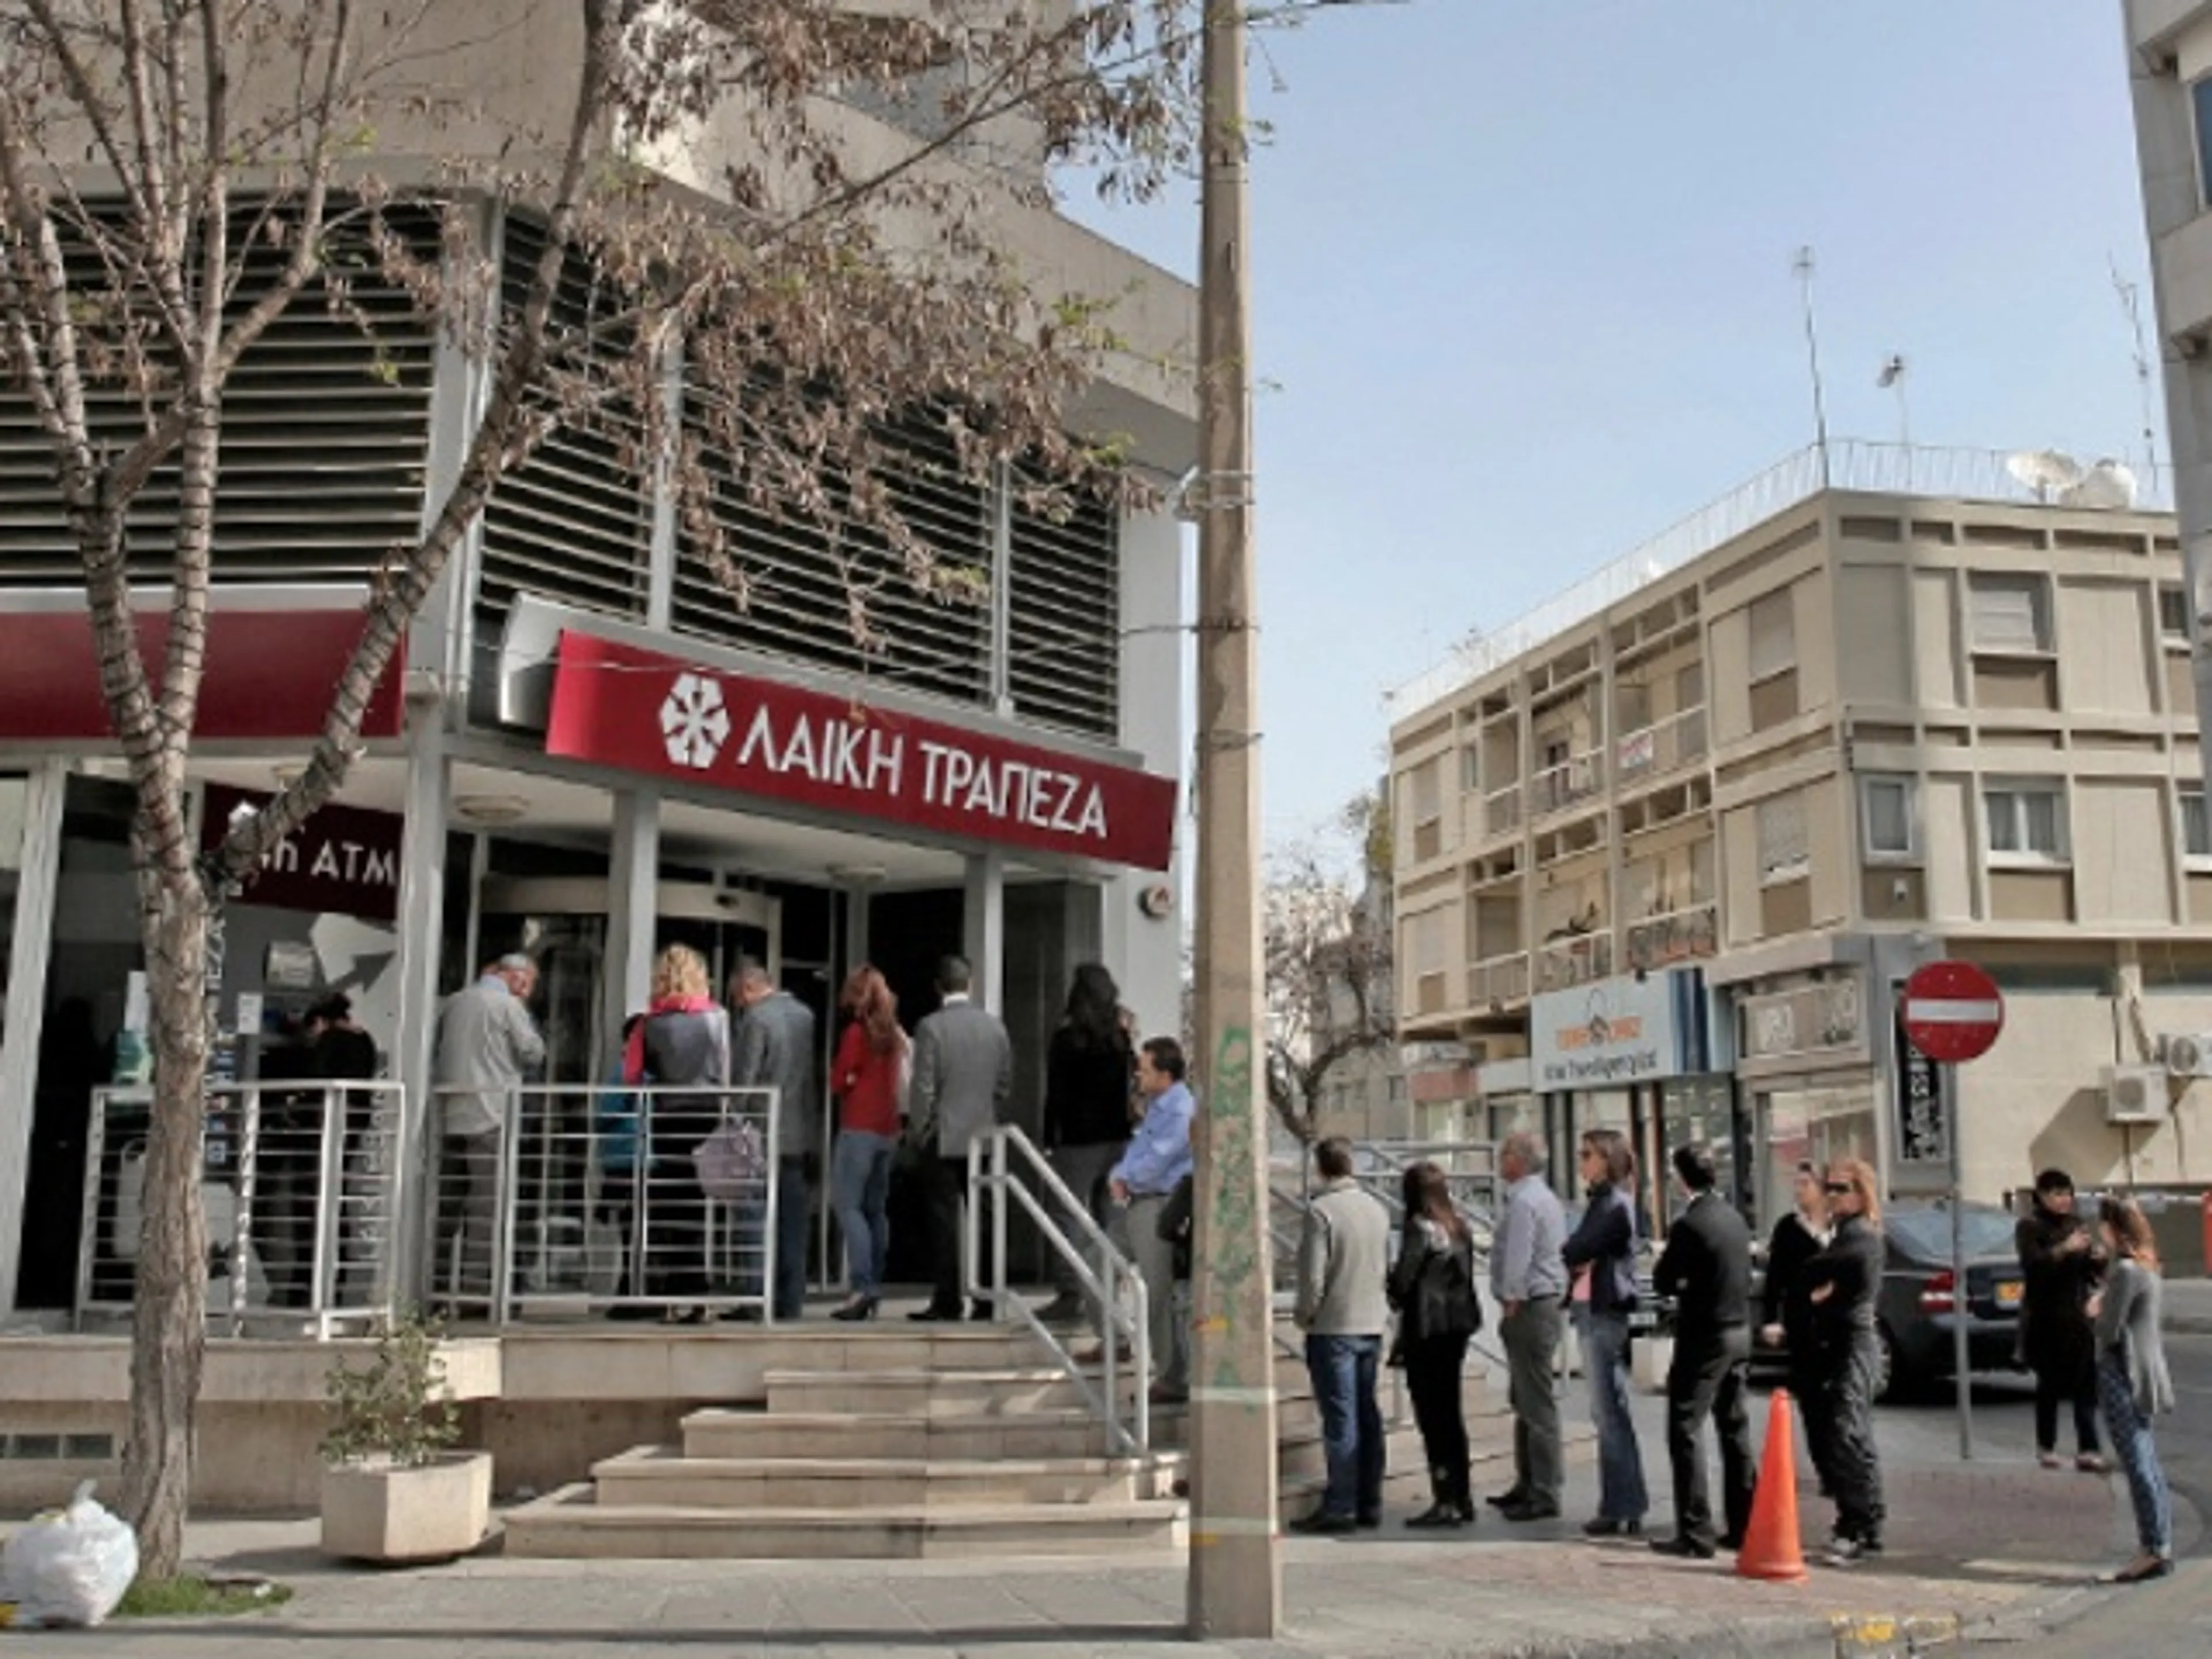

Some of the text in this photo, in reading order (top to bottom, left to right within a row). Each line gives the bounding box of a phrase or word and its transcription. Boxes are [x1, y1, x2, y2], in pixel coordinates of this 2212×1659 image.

[737, 704, 1108, 839] ΛΑΙΚΗ ΤΡΑΠΕΖΑ
[310, 839, 397, 886] ATM
